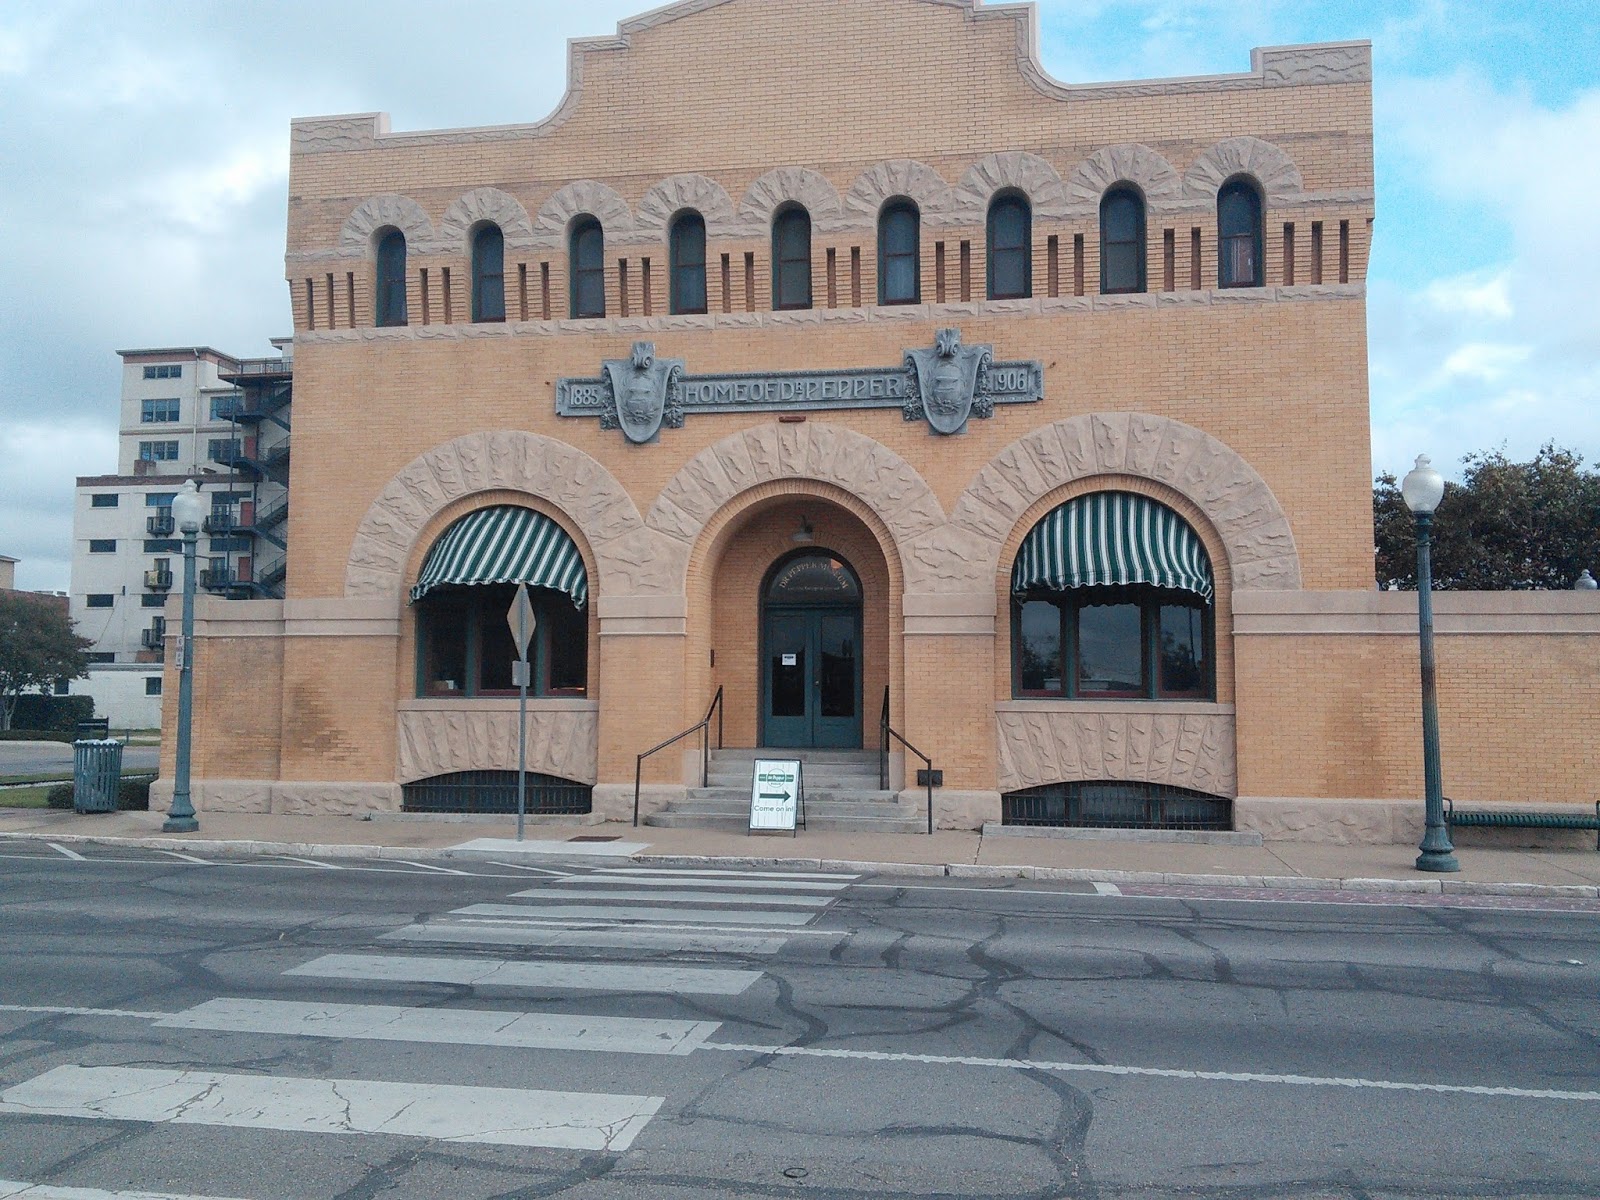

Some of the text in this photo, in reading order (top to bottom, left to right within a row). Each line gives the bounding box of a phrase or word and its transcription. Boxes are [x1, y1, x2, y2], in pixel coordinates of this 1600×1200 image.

[685, 380, 748, 403] HOME
[749, 380, 775, 401] OF
[806, 377, 900, 399] PEPPER
[994, 370, 1026, 392] 1906
[570, 385, 600, 405] 1885
[787, 562, 817, 578] PEPPER
[819, 563, 849, 589] MEUM
